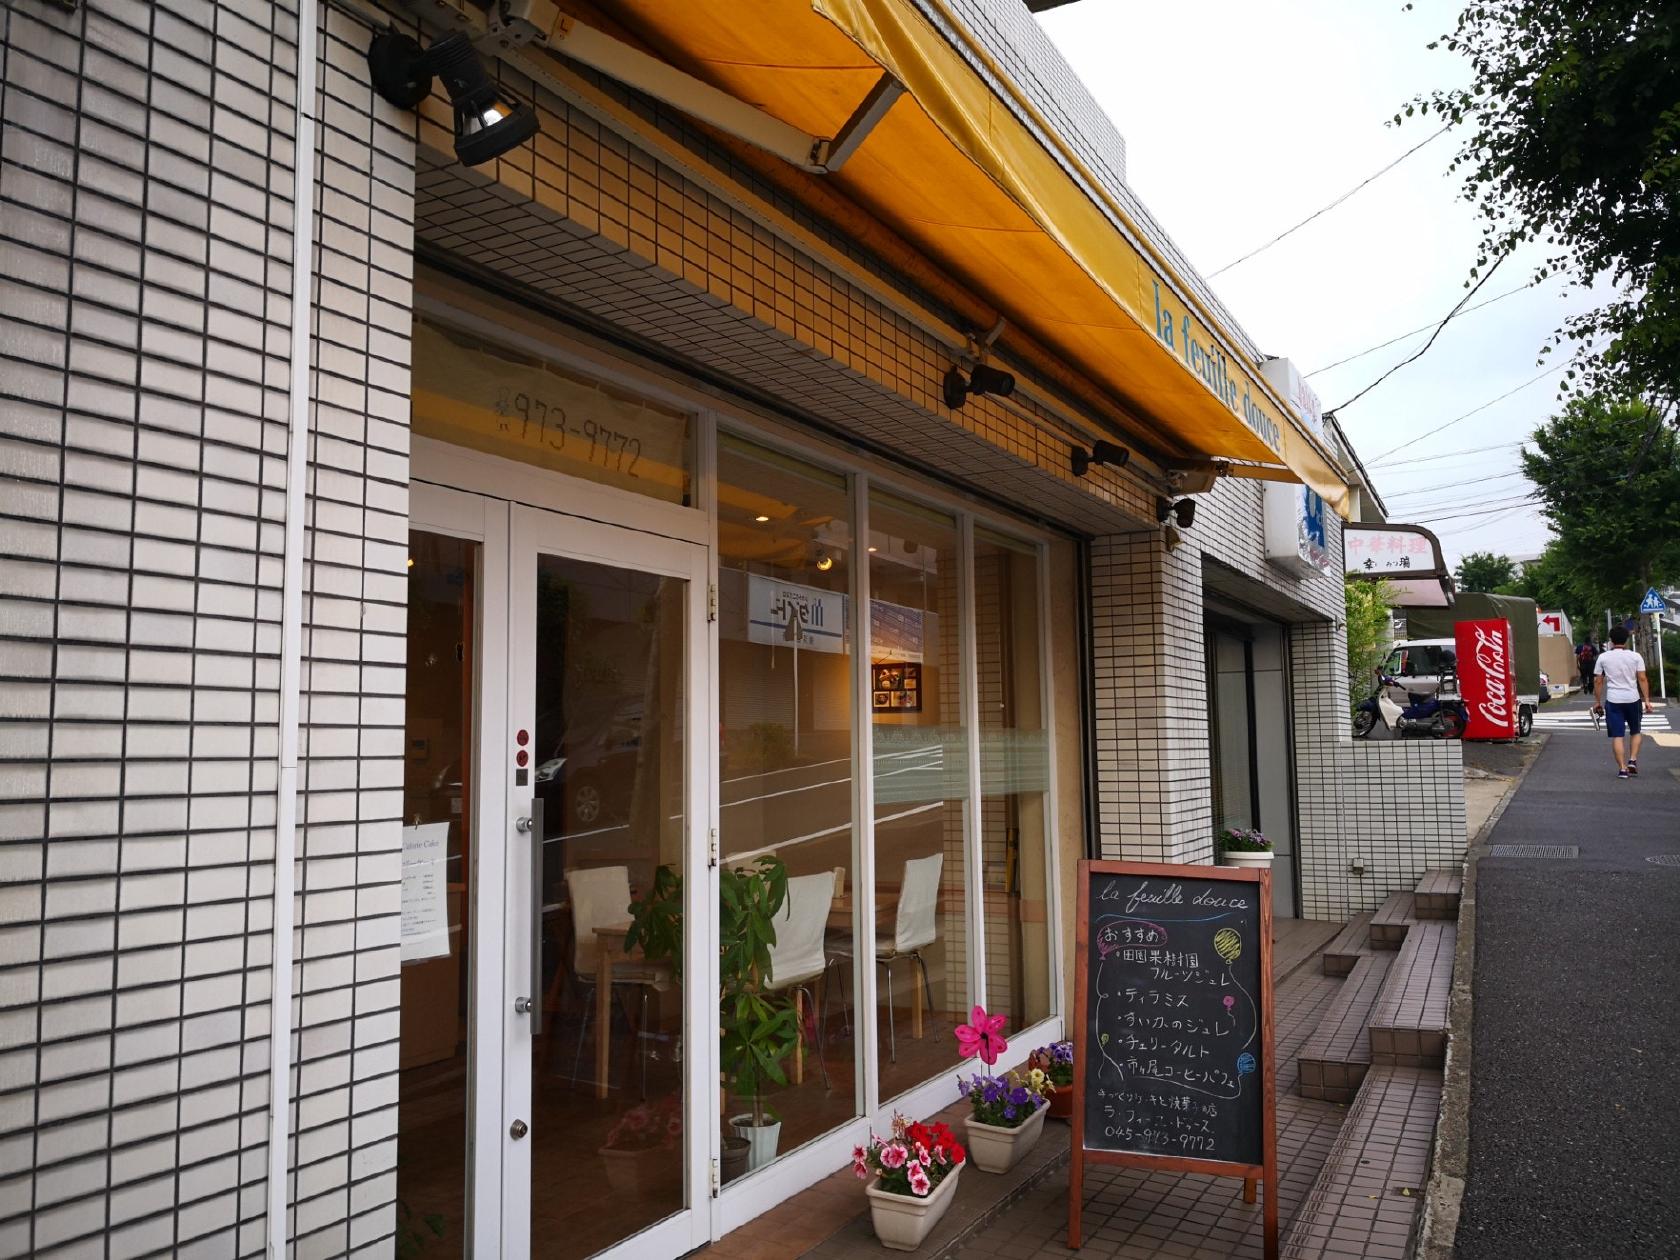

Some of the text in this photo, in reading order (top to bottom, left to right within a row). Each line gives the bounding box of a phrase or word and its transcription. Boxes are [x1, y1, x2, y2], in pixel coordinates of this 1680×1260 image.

[1152, 280, 1281, 453] la feuille douce
[514, 393, 641, 479] 973-9772
[1348, 534, 1427, 555] 中華料理
[1474, 623, 1509, 728] Coca-Cola
[1096, 880, 1249, 914] la feuille douce
[1104, 926, 1159, 943] おすすめ
